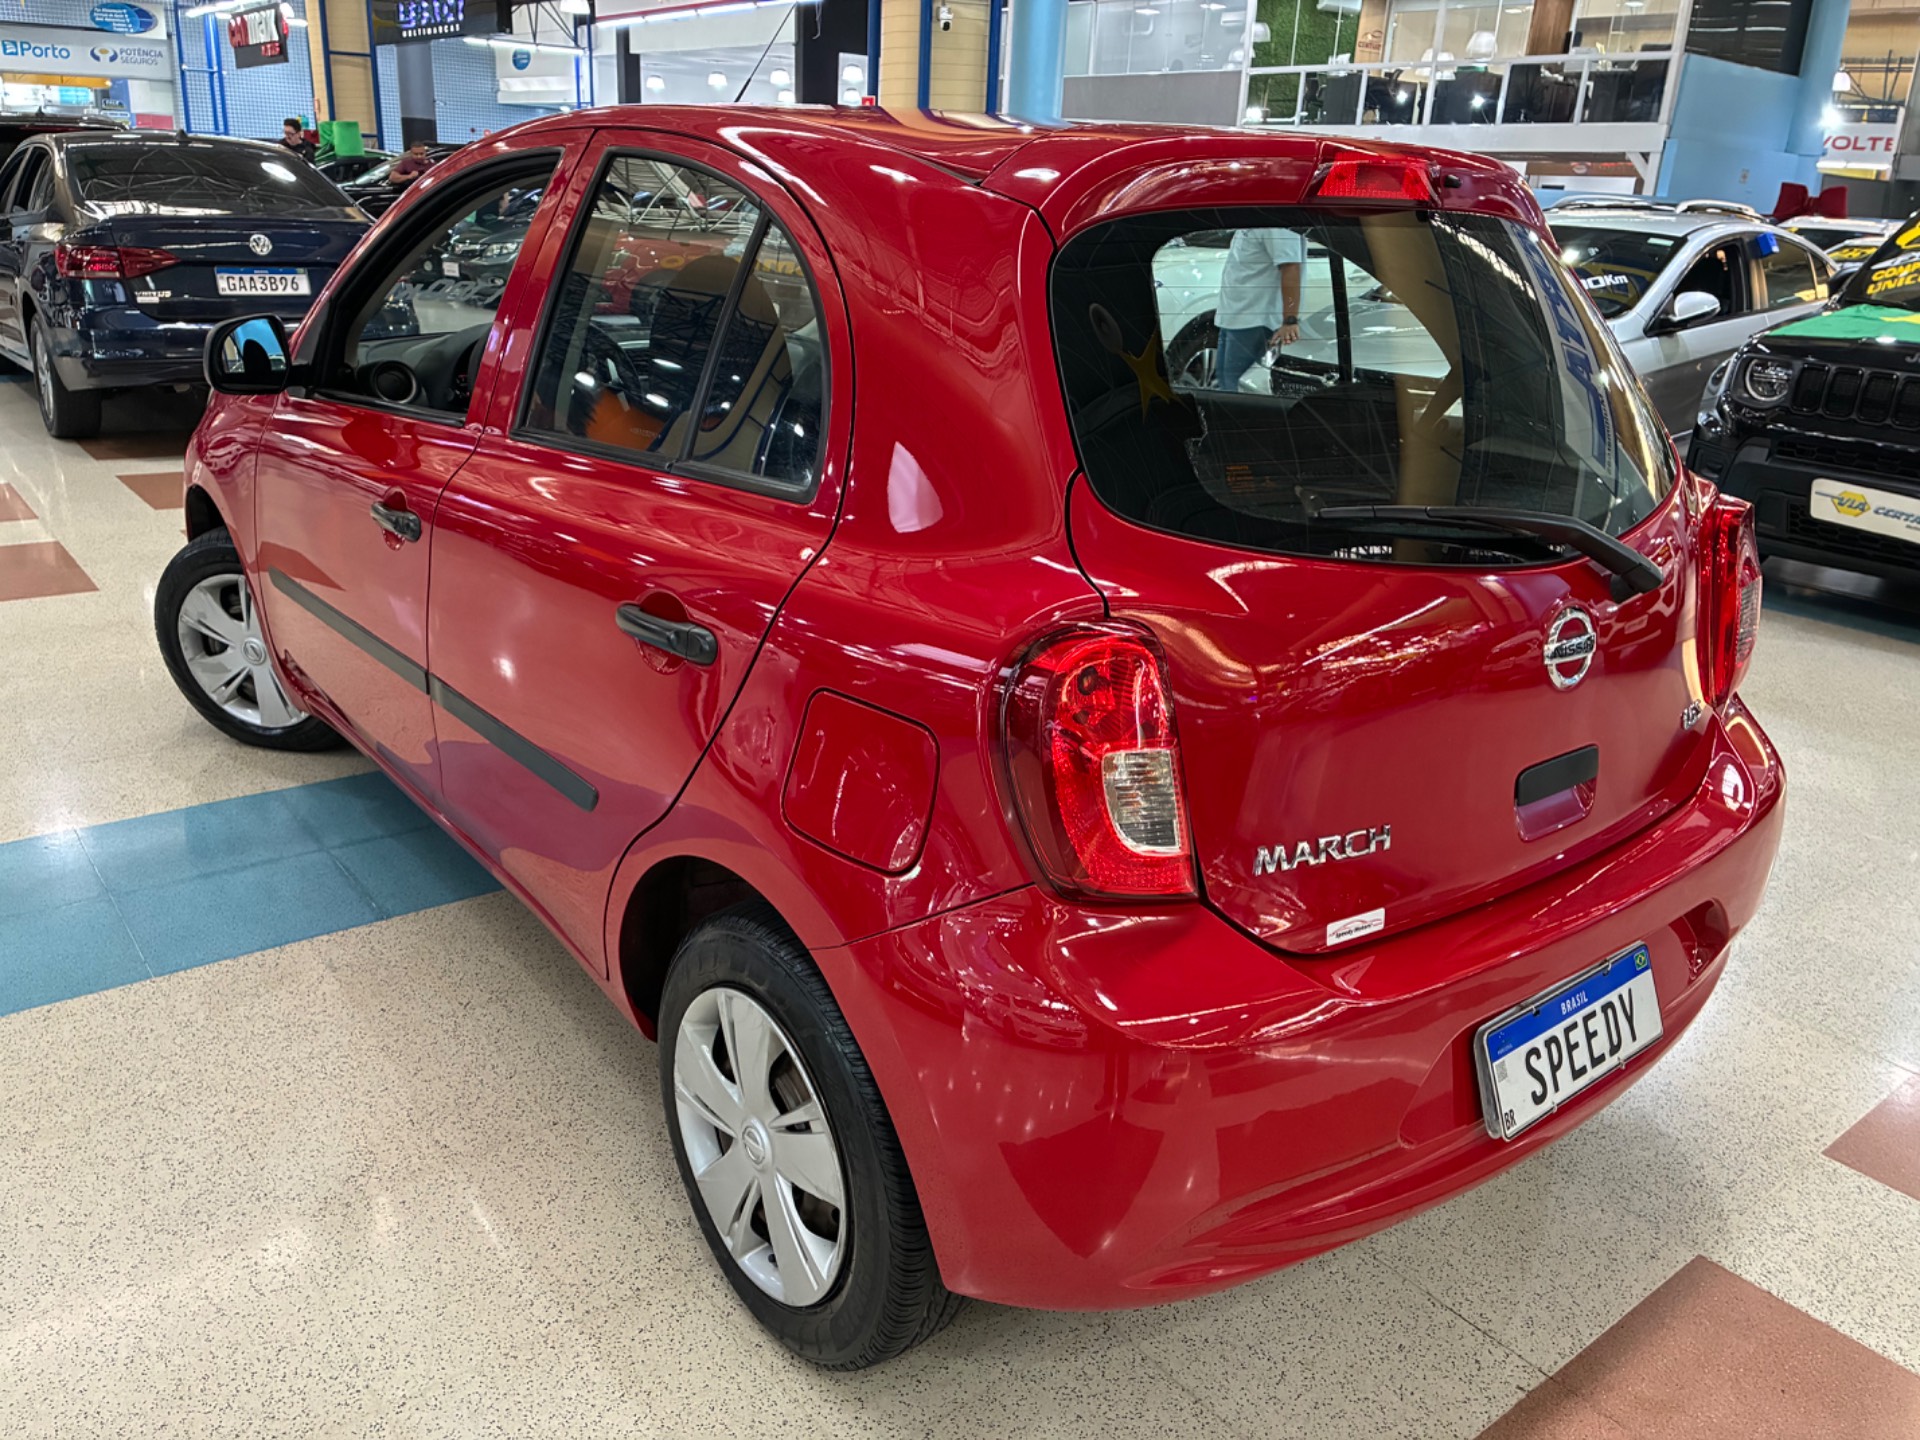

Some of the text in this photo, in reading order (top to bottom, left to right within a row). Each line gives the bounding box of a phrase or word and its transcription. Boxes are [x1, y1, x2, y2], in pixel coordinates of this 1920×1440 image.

[20, 41, 71, 60] Porto
[119, 47, 163, 59] POTÊNCIA
[120, 56, 158, 66] SEGUROS
[226, 275, 300, 292] GAA3B96
[1837, 497, 1867, 512] VIA
[1545, 637, 1595, 659] NISSAN
[1253, 824, 1391, 877] MARCH
[1560, 990, 1589, 1016] BRASIL
[1525, 987, 1638, 1105] SPEEDY
[1503, 1108, 1517, 1131] BR
